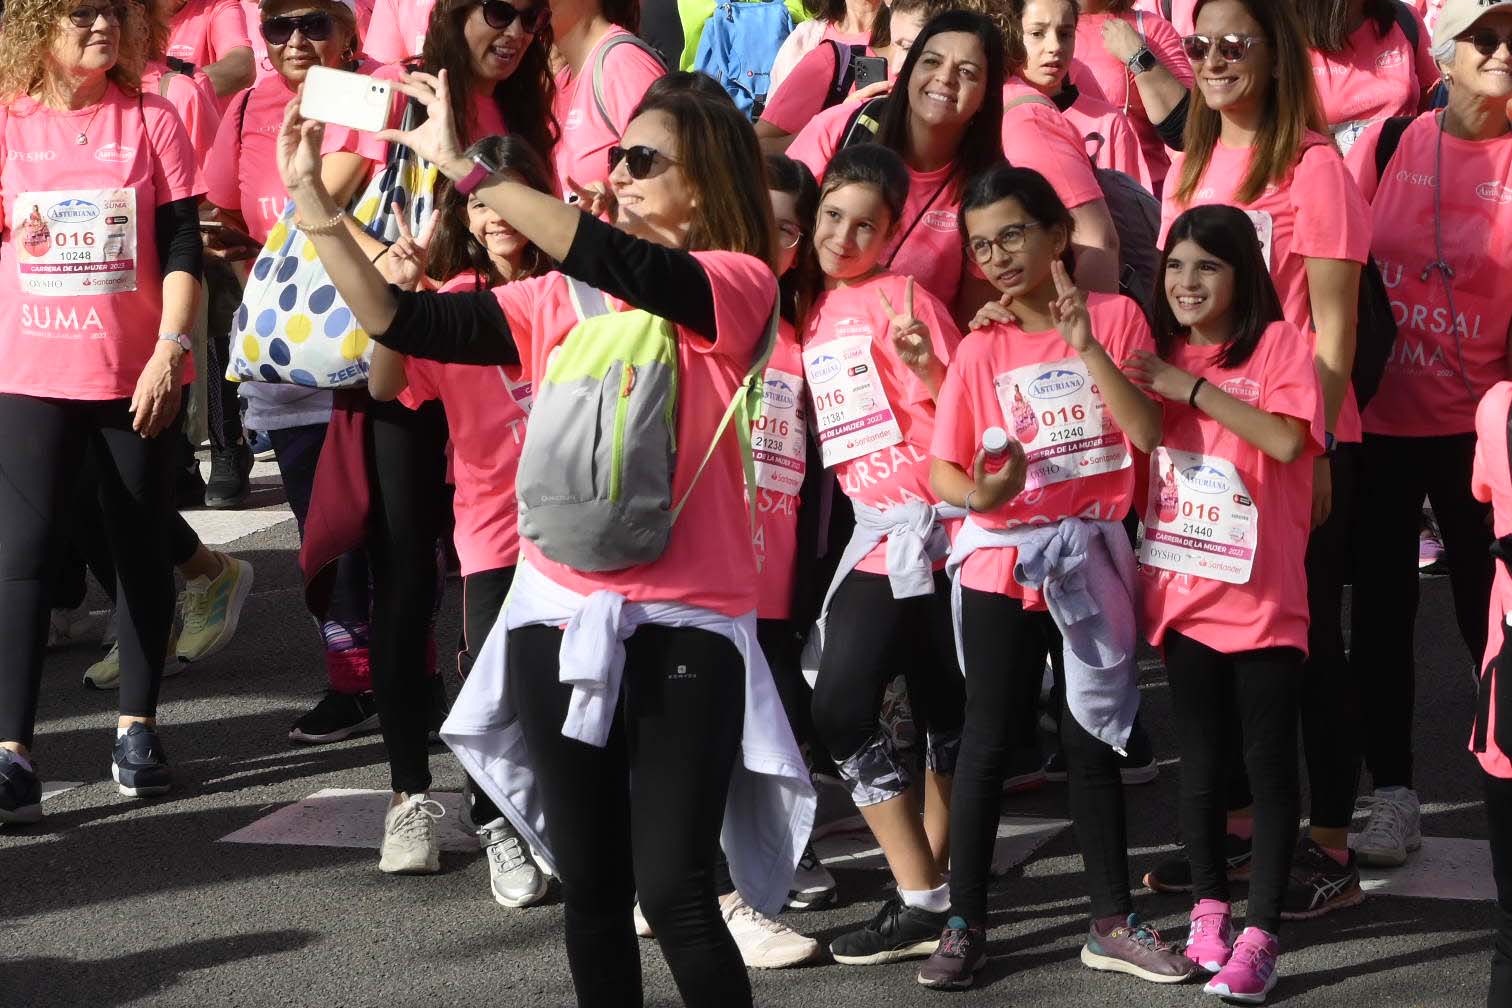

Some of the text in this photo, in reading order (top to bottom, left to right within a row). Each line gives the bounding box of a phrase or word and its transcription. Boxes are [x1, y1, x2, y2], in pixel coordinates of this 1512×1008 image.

[51, 209, 96, 218] ASTURIANA
[55, 232, 96, 247] 016
[60, 251, 91, 261] 10248
[21, 303, 104, 330] SUMA
[1390, 300, 1481, 339] ORSAL
[1388, 340, 1446, 367] UMA
[1033, 378, 1081, 395] ASTURIANA
[762, 389, 793, 406] STURIANA
[816, 389, 845, 411] 016
[1041, 404, 1085, 427] 016
[755, 415, 789, 437] 016
[843, 421, 865, 433] MUJER
[1050, 426, 1084, 442] 21240
[756, 436, 783, 452] 21238
[844, 443, 927, 493] ORSAL
[757, 489, 793, 516] SAL
[1182, 501, 1220, 522] 016
[1183, 523, 1213, 538] 21440
[1155, 533, 1183, 544] CARRERA
[1193, 541, 1203, 549] LA
[1203, 543, 1227, 553] MUJER
